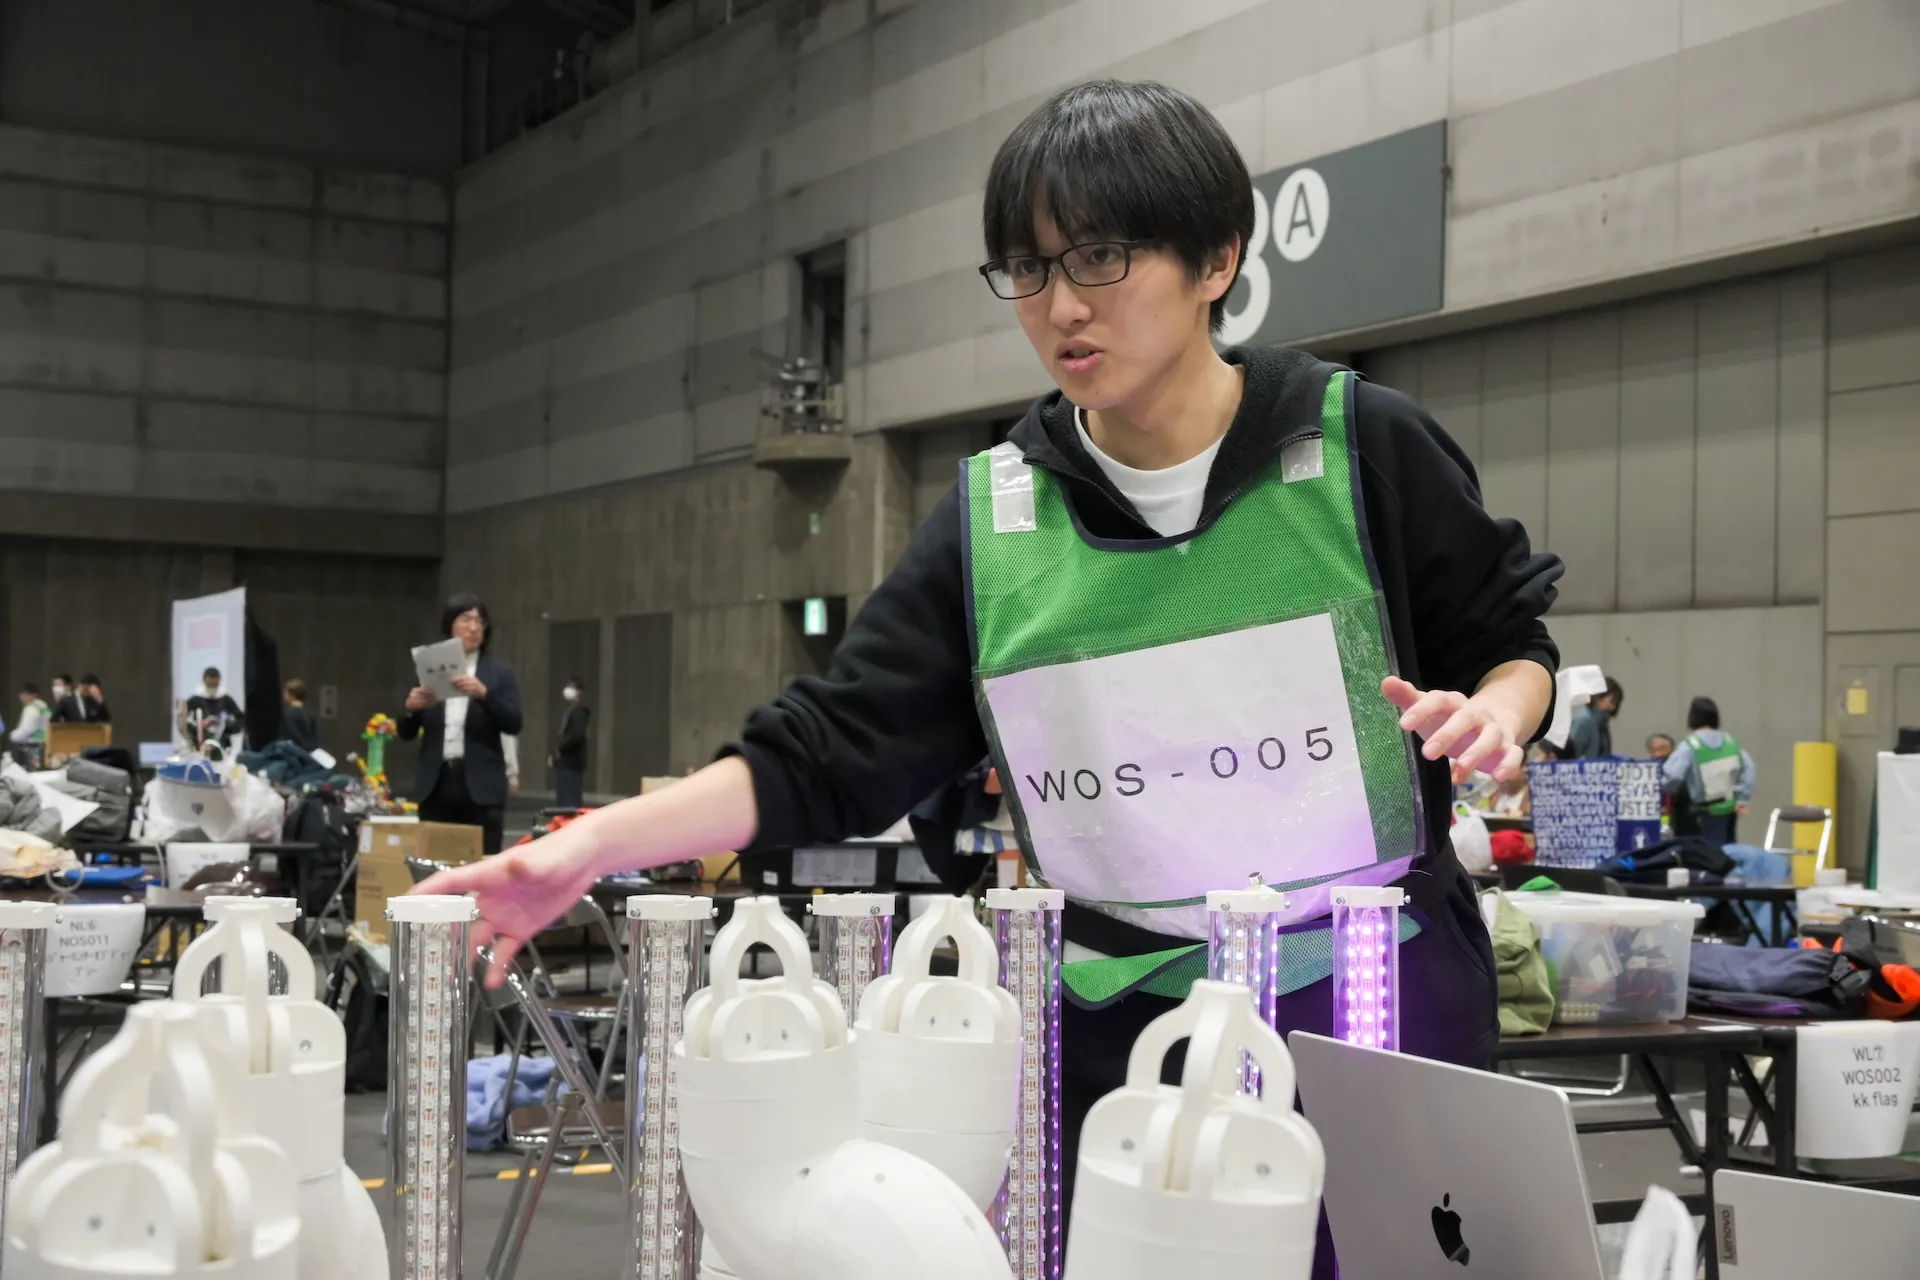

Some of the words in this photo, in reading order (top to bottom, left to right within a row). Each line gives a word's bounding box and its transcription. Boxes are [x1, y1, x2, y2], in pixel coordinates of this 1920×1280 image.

[1842, 1067, 1902, 1085] WOS002
[1852, 1092, 1871, 1108] kk
[1872, 1090, 1898, 1108] flag
[1722, 1209, 1734, 1260] Lenovo
